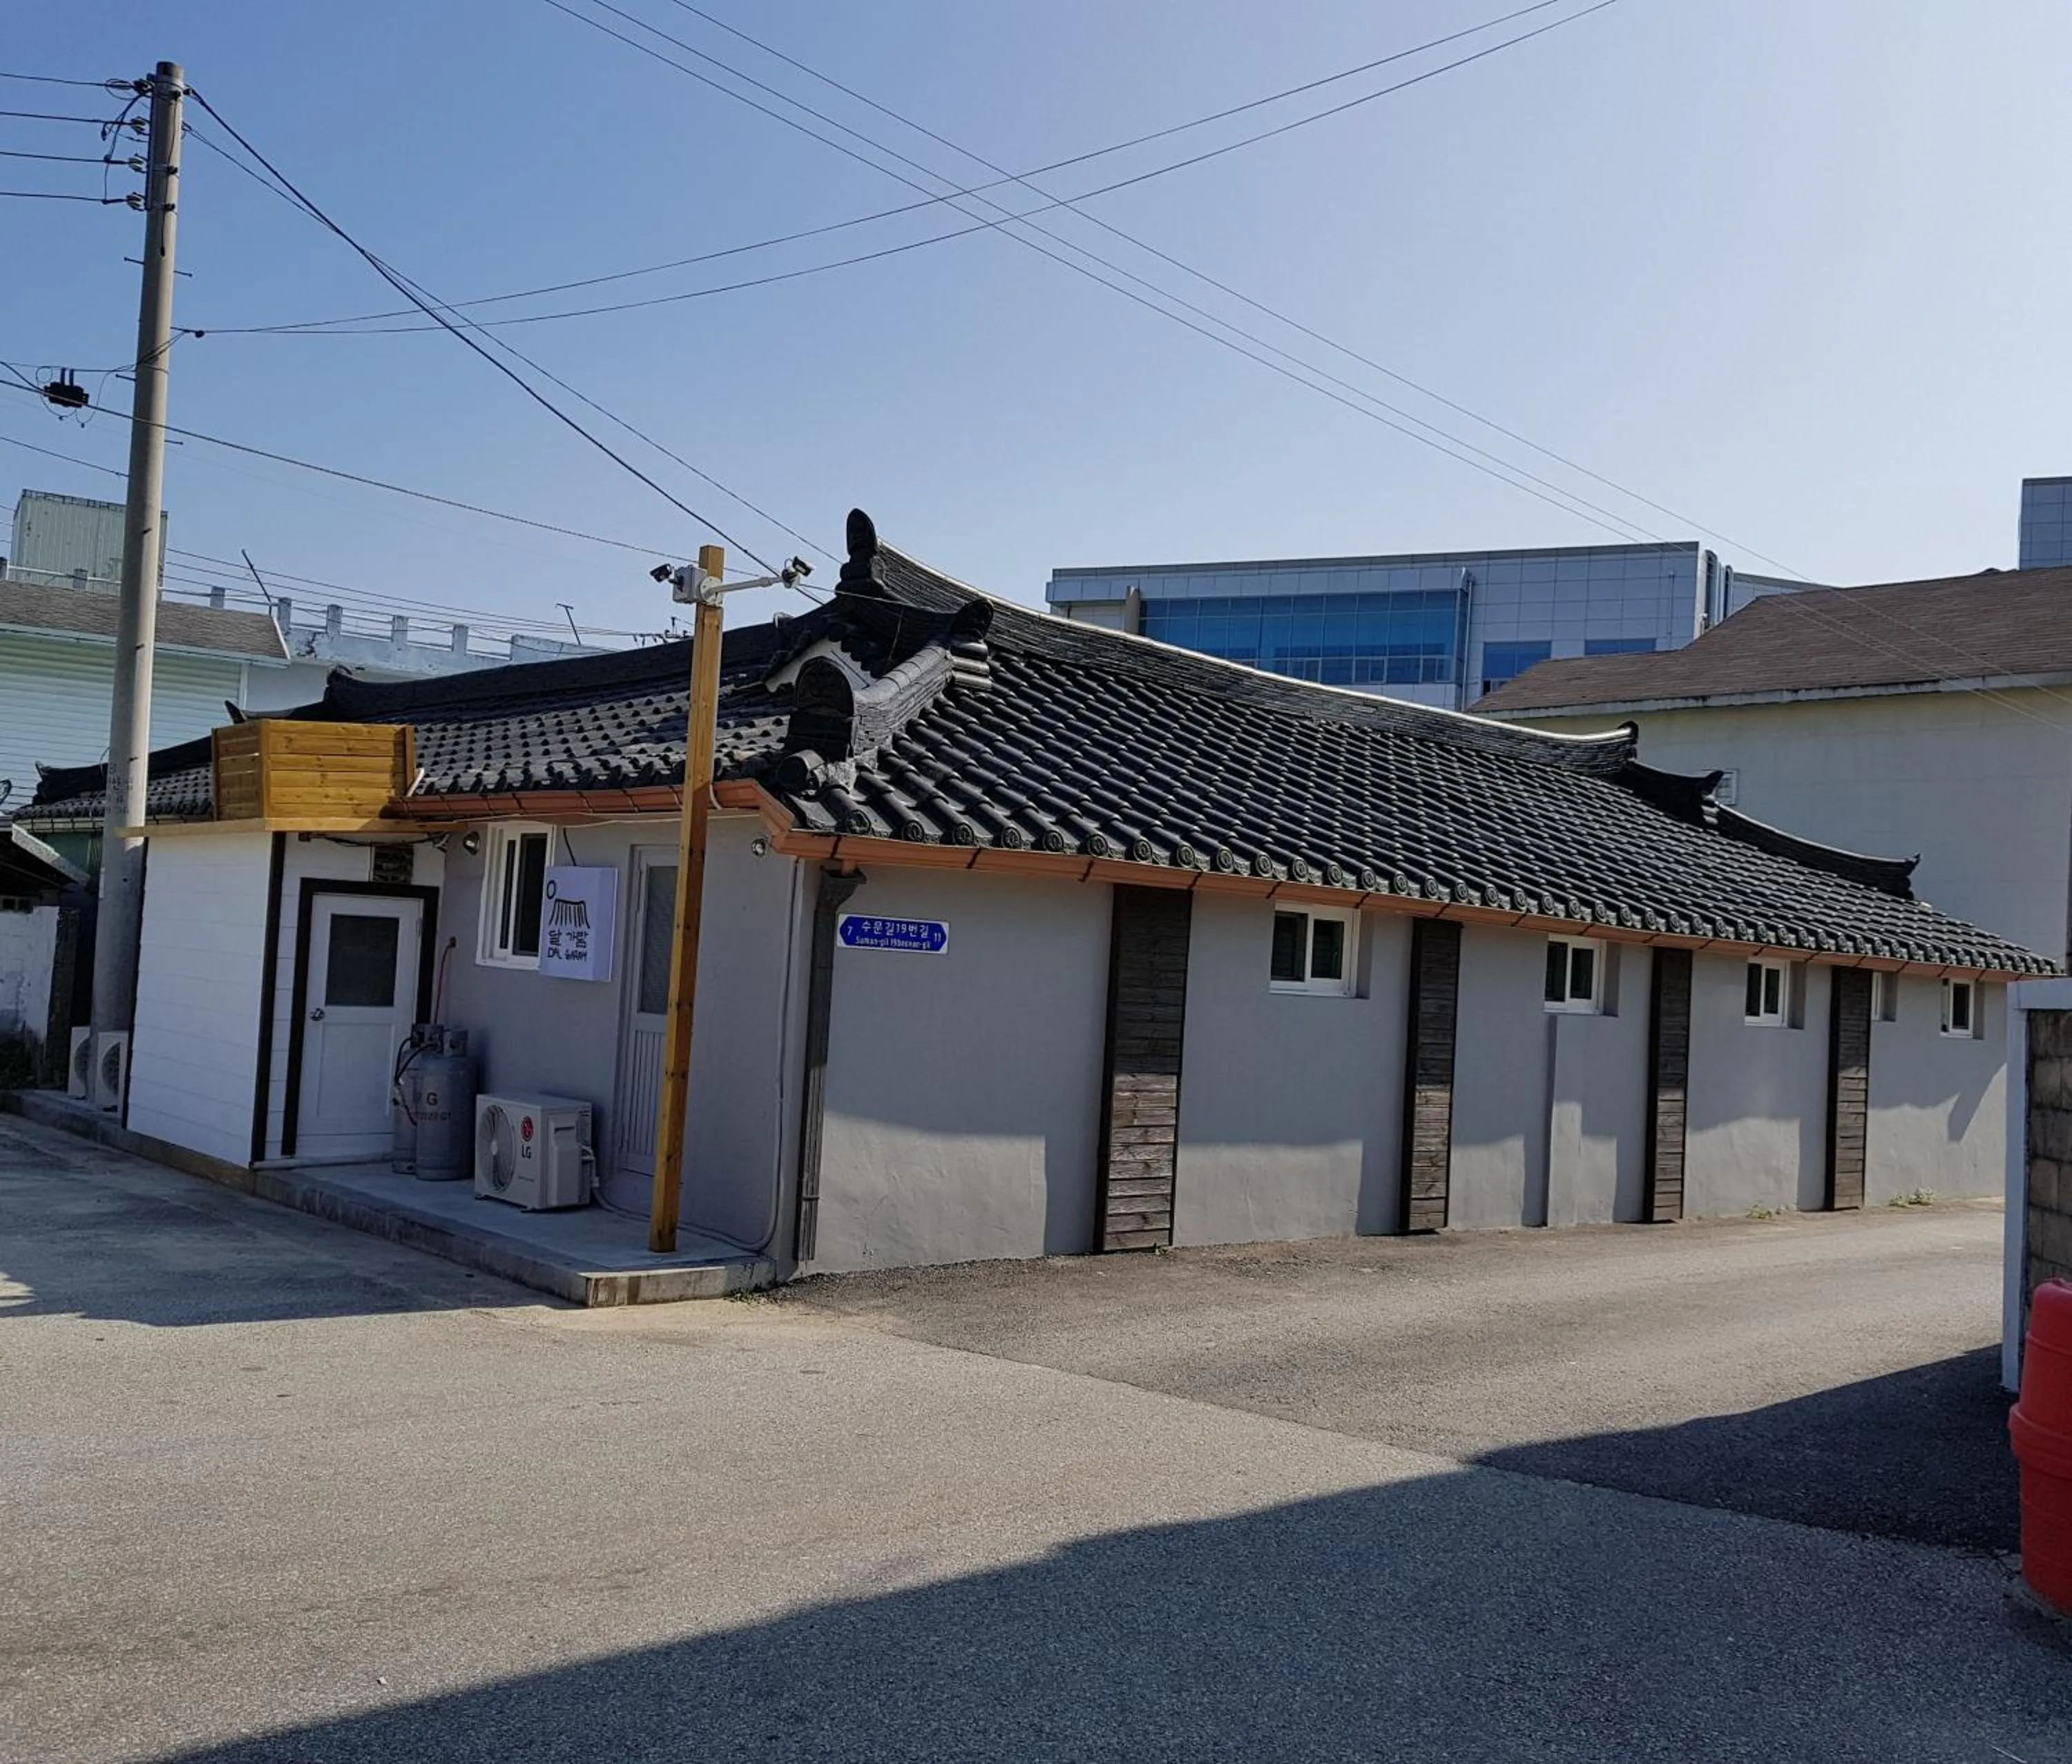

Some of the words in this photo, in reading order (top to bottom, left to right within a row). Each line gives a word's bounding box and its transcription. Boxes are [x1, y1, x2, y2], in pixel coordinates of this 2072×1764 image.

[847, 926, 854, 936] 7
[934, 932, 941, 942] 11
[548, 929, 562, 946] 달
[566, 930, 589, 948] 가람
[548, 947, 562, 959] DAL
[521, 1145, 531, 1159] LG
